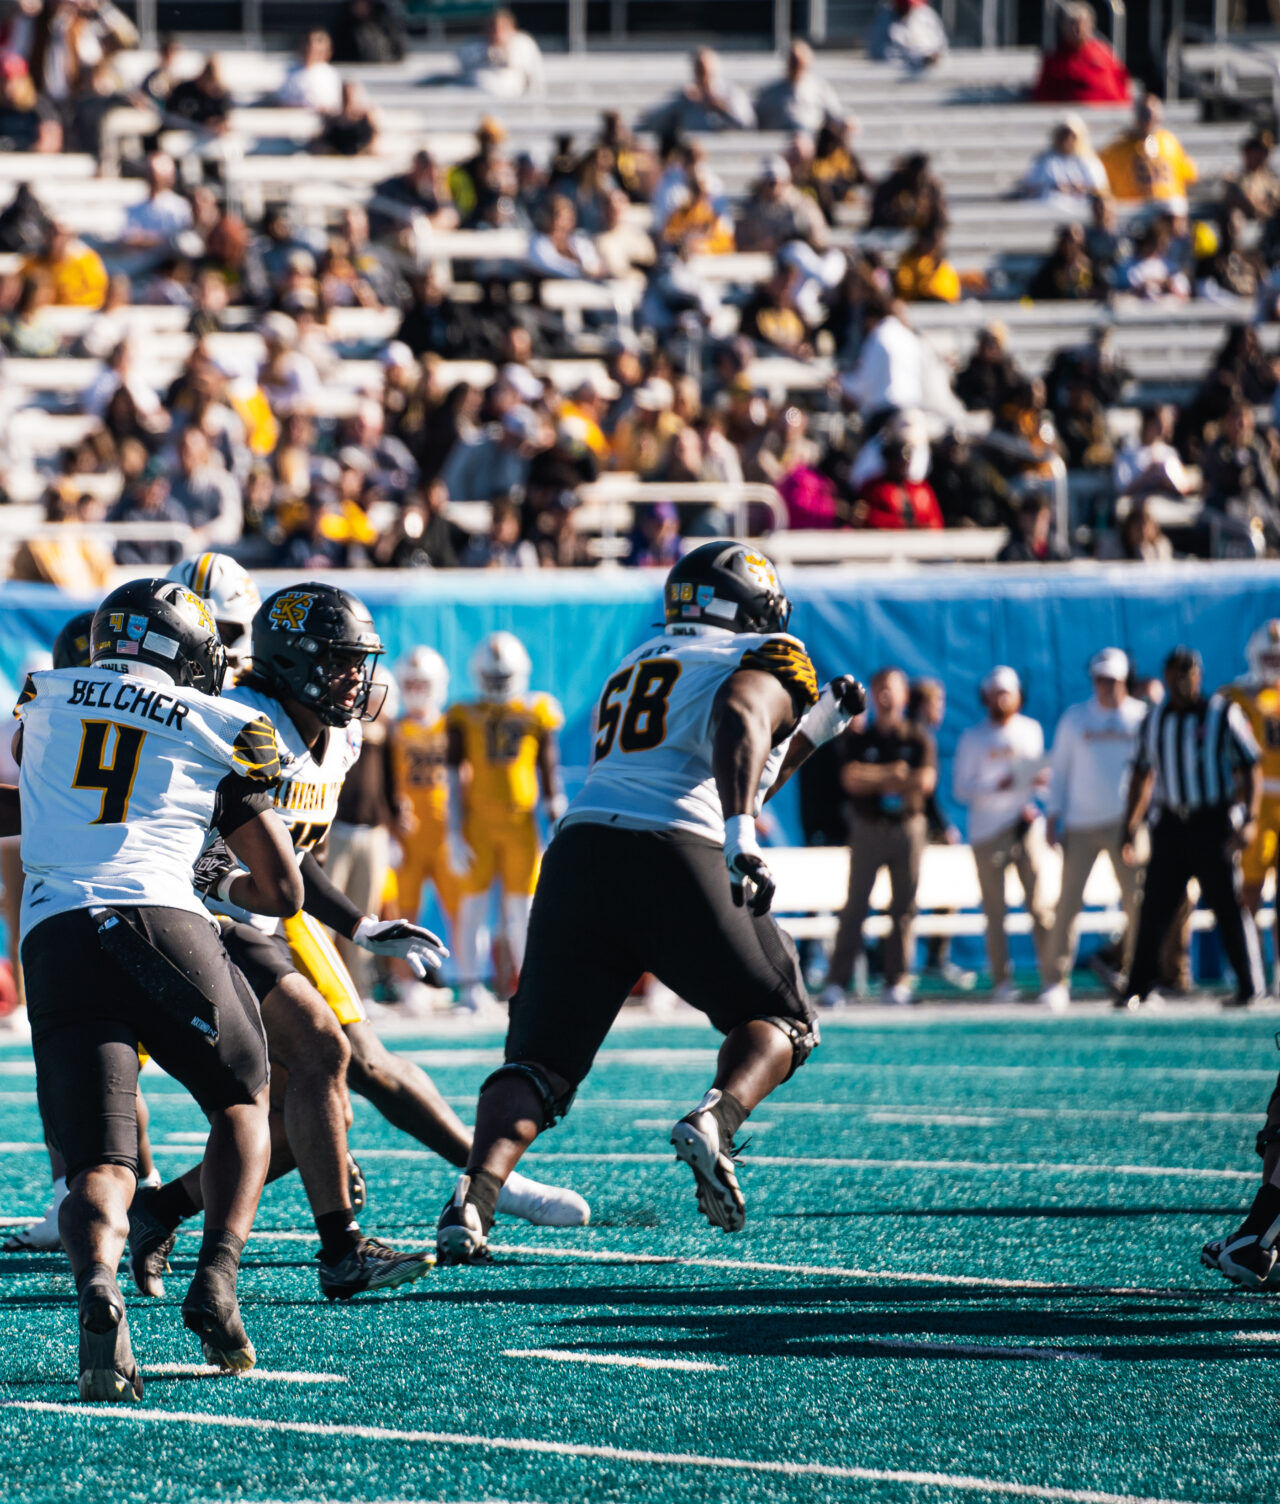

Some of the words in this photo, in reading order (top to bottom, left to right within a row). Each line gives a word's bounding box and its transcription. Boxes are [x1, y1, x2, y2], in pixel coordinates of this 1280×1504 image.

[109, 612, 124, 632] 4
[67, 679, 190, 731] BELCHER
[594, 658, 682, 764] 58
[70, 718, 147, 825] 4
